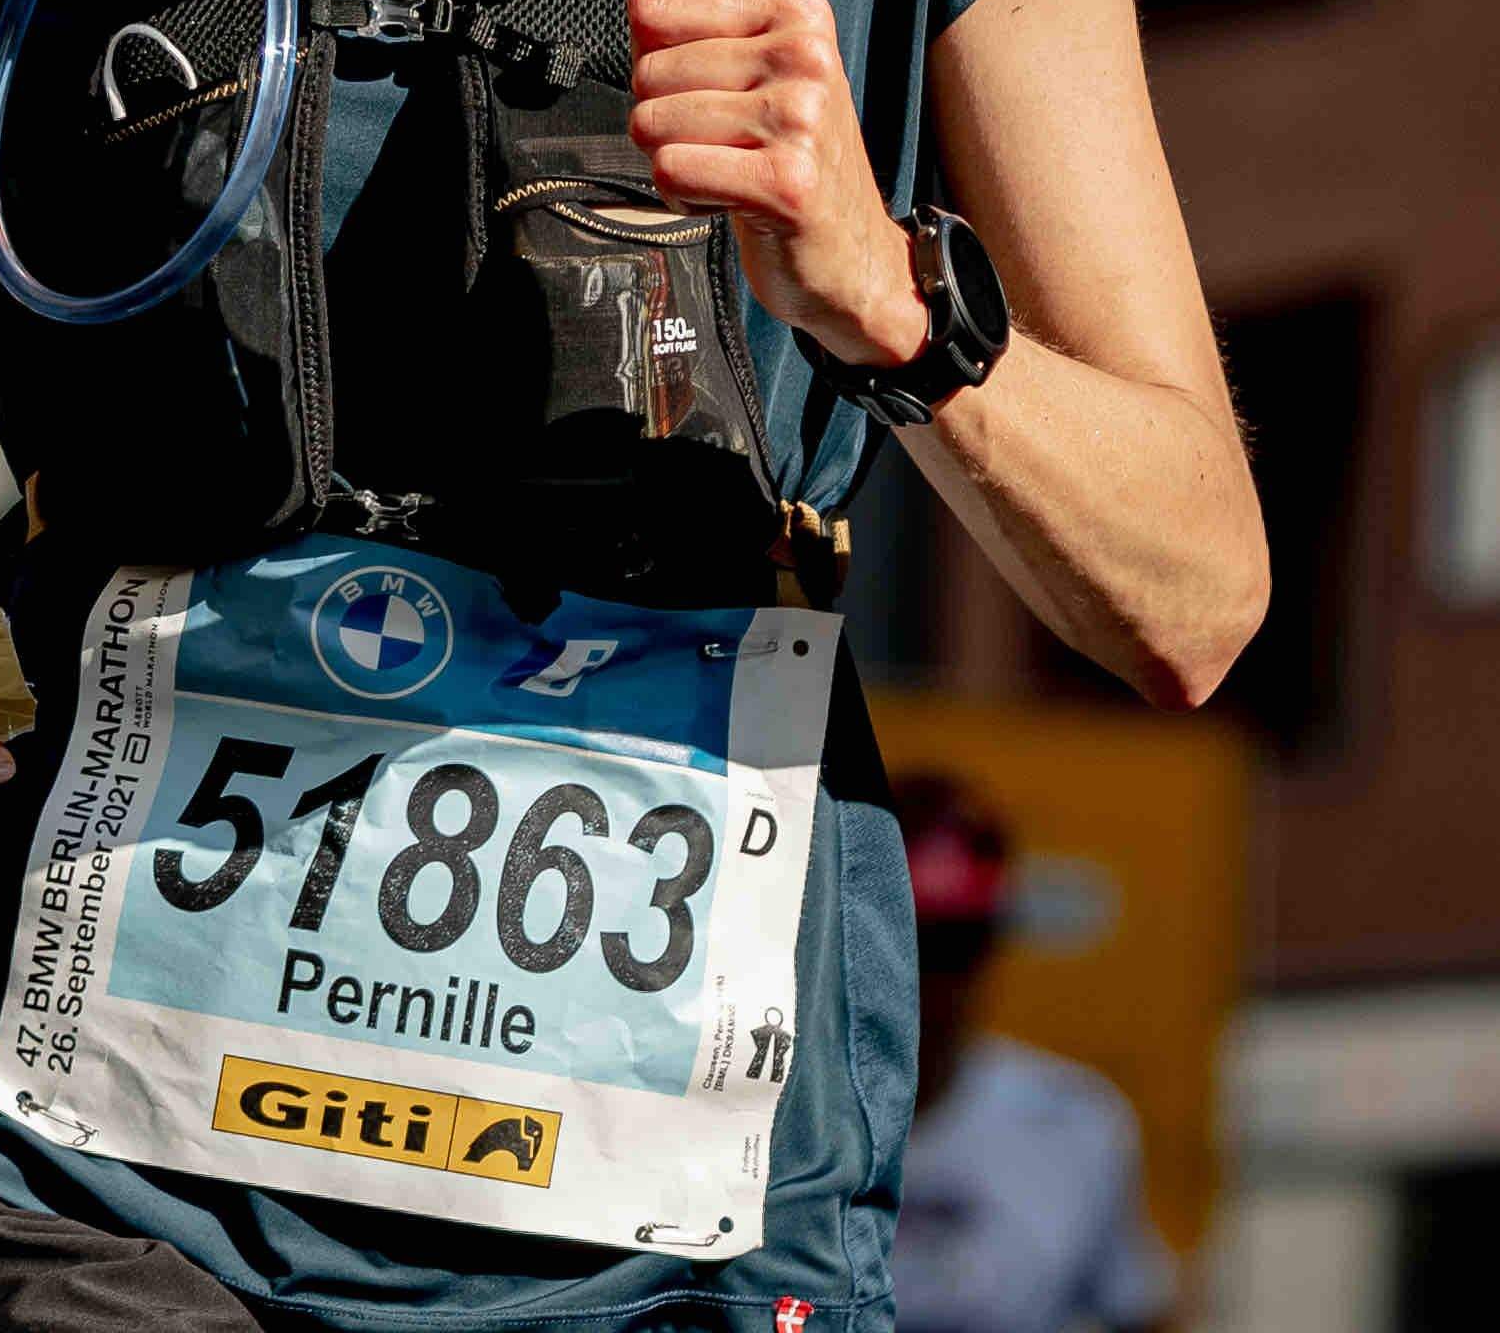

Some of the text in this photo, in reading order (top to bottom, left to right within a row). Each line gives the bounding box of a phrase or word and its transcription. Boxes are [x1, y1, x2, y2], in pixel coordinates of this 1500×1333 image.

[653, 341, 674, 355] SOFT
[339, 574, 440, 618] BMW
[135, 686, 143, 727] ABBOTT
[144, 691, 152, 728] WORLD
[16, 578, 150, 1068] 47. BMW BERLIN-MARATHON
[740, 807, 777, 857] D
[153, 736, 714, 993] 51863
[48, 774, 140, 1075] 26. September 2021
[277, 948, 536, 1054] Pernille
[240, 1081, 433, 1153] Giti
